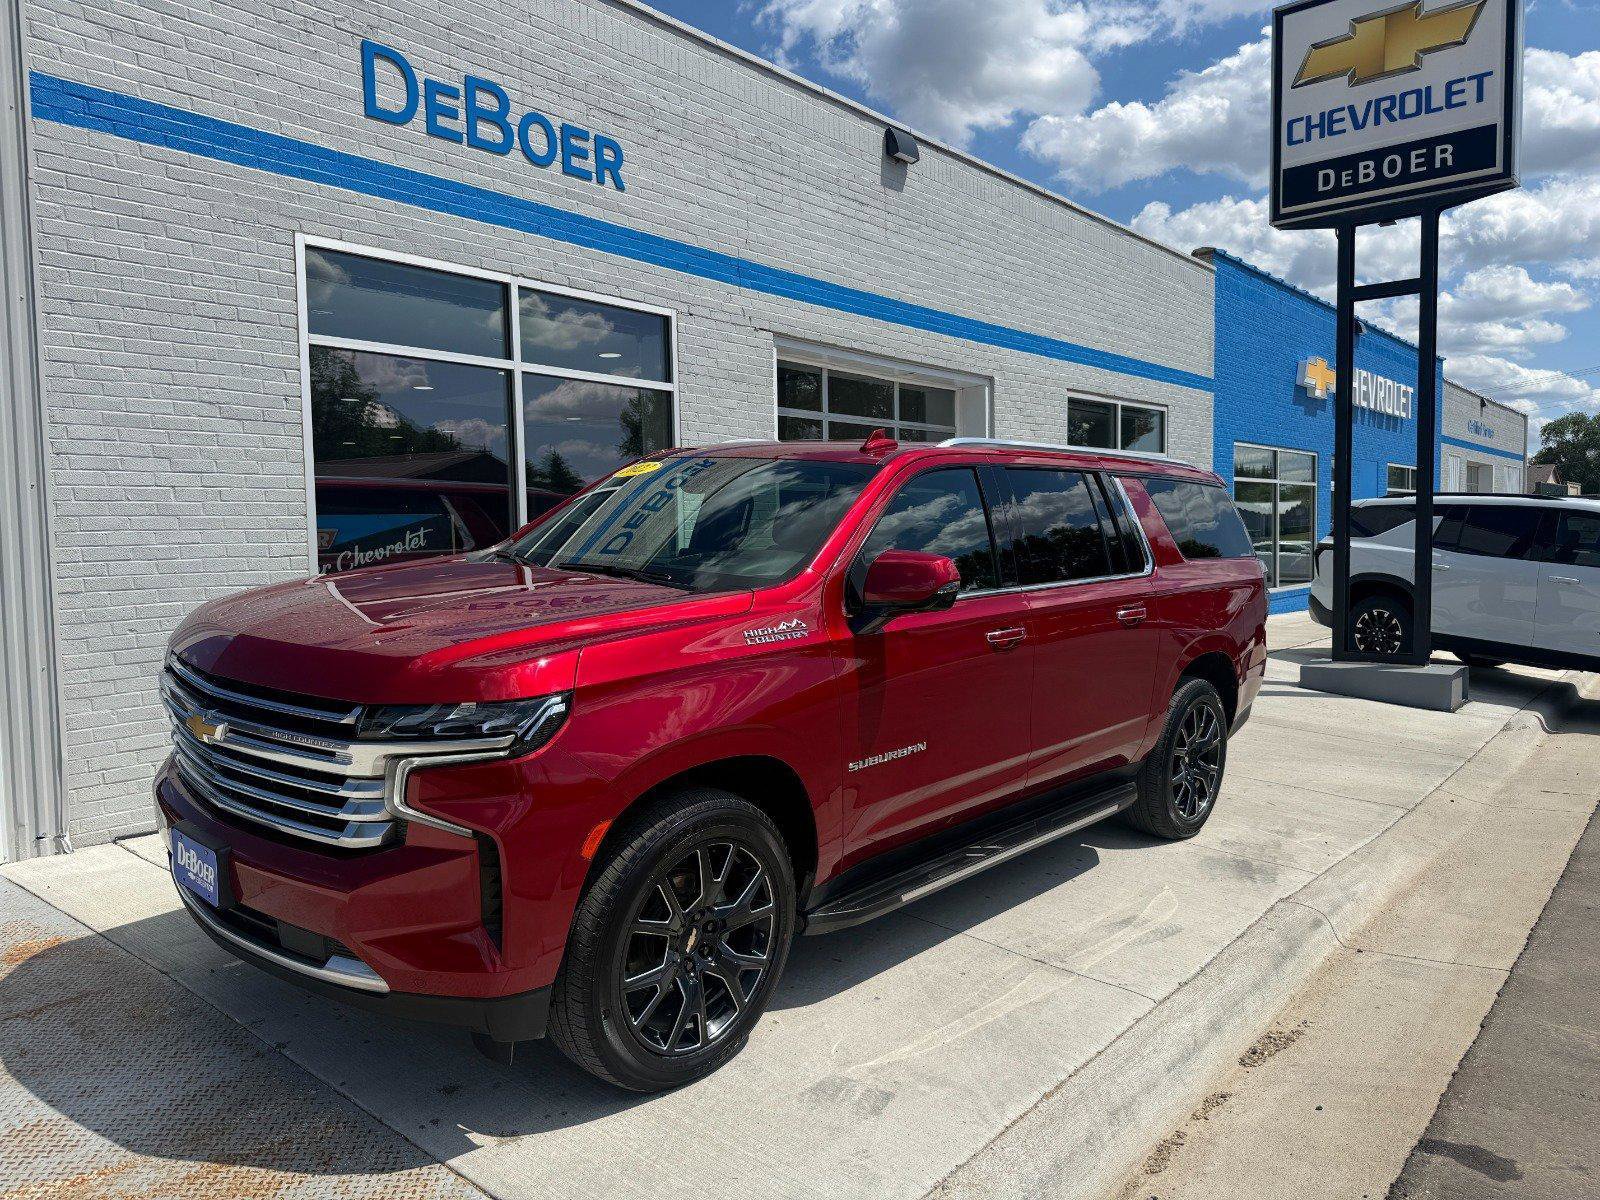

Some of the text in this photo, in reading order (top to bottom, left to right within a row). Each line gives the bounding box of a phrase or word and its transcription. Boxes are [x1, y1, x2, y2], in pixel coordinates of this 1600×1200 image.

[361, 39, 625, 191] DEBOER
[1286, 70, 1494, 147] CHEVROLET
[1317, 143, 1454, 192] DEBOER
[1353, 368, 1414, 419] HEVROLET
[336, 527, 433, 571] Chevrolet
[743, 627, 777, 638] HIGH
[745, 630, 808, 645] COUNTRY
[848, 741, 927, 772] SUBURBAN
